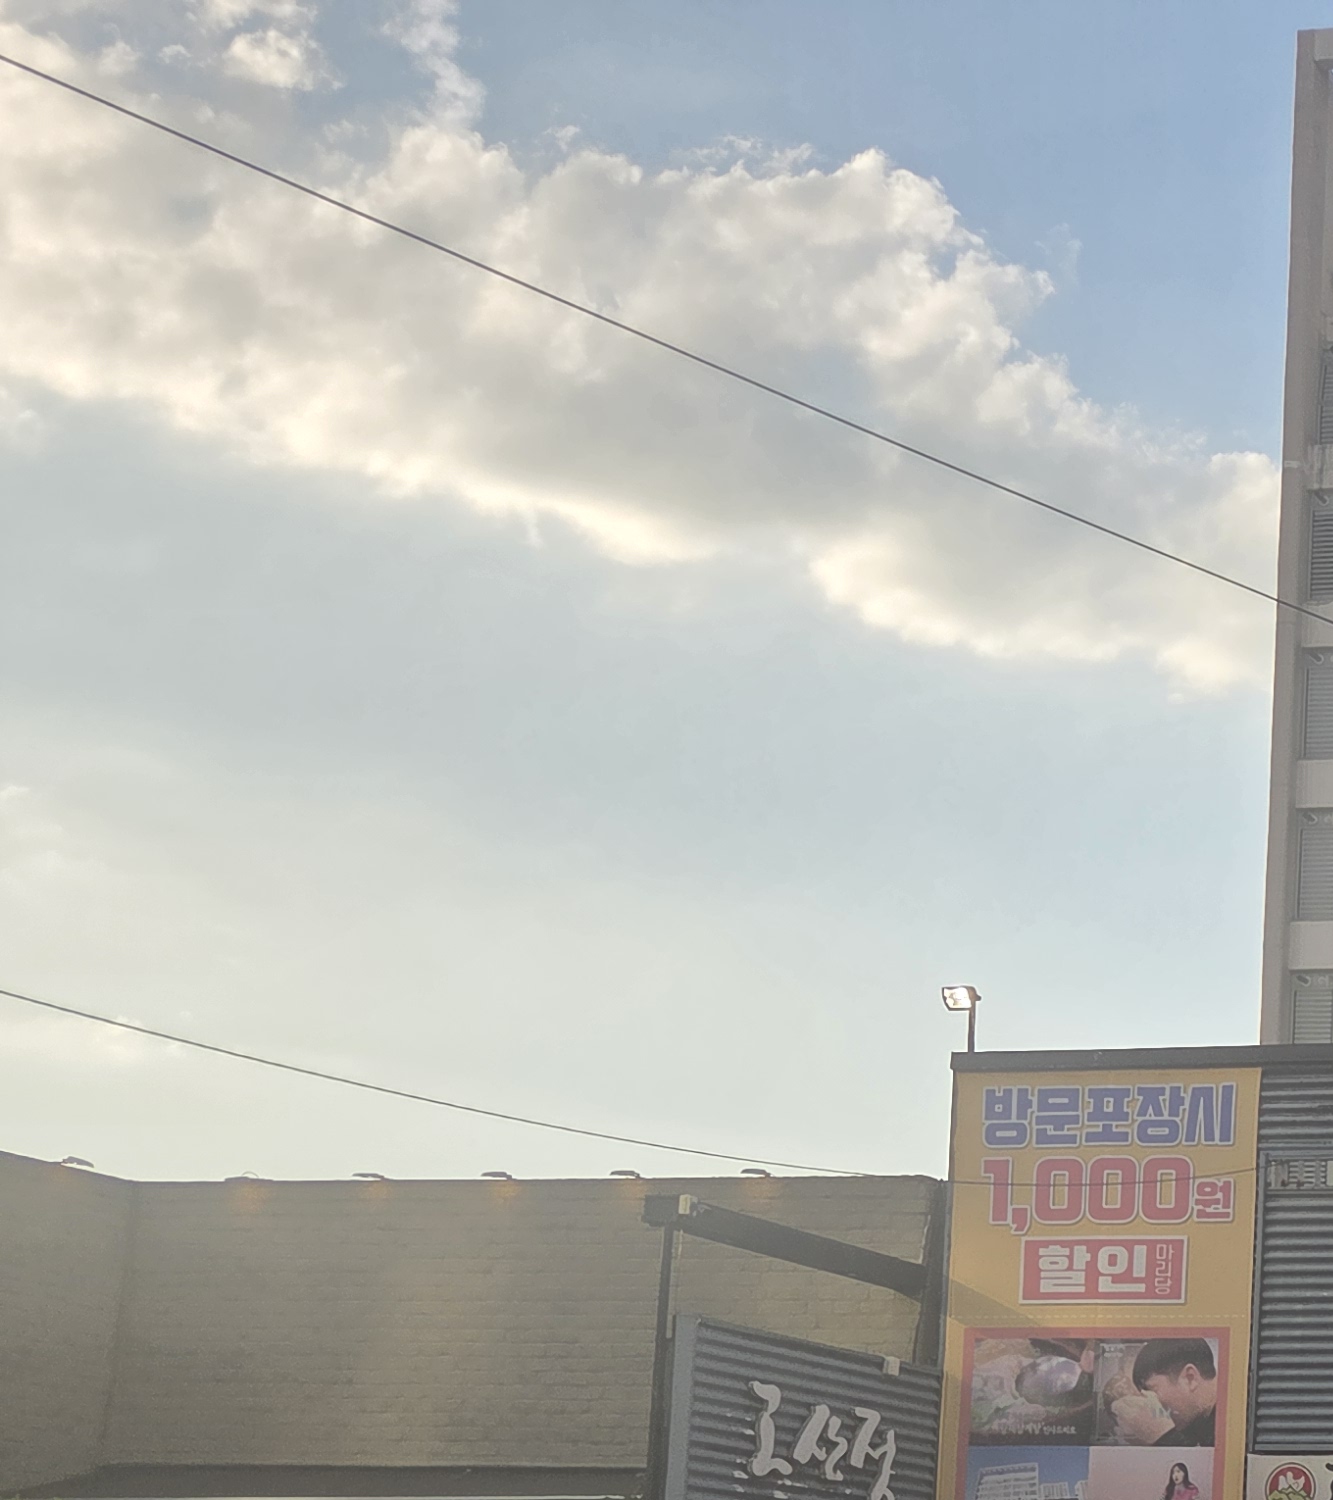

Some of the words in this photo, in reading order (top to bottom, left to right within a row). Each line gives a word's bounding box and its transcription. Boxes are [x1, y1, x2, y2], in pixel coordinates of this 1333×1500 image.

[982, 1081, 1237, 1149] 방문포장시
[981, 1153, 1235, 1235] 1,000원
[1038, 1244, 1148, 1293] 할인
[1154, 1243, 1175, 1295] 마리당
